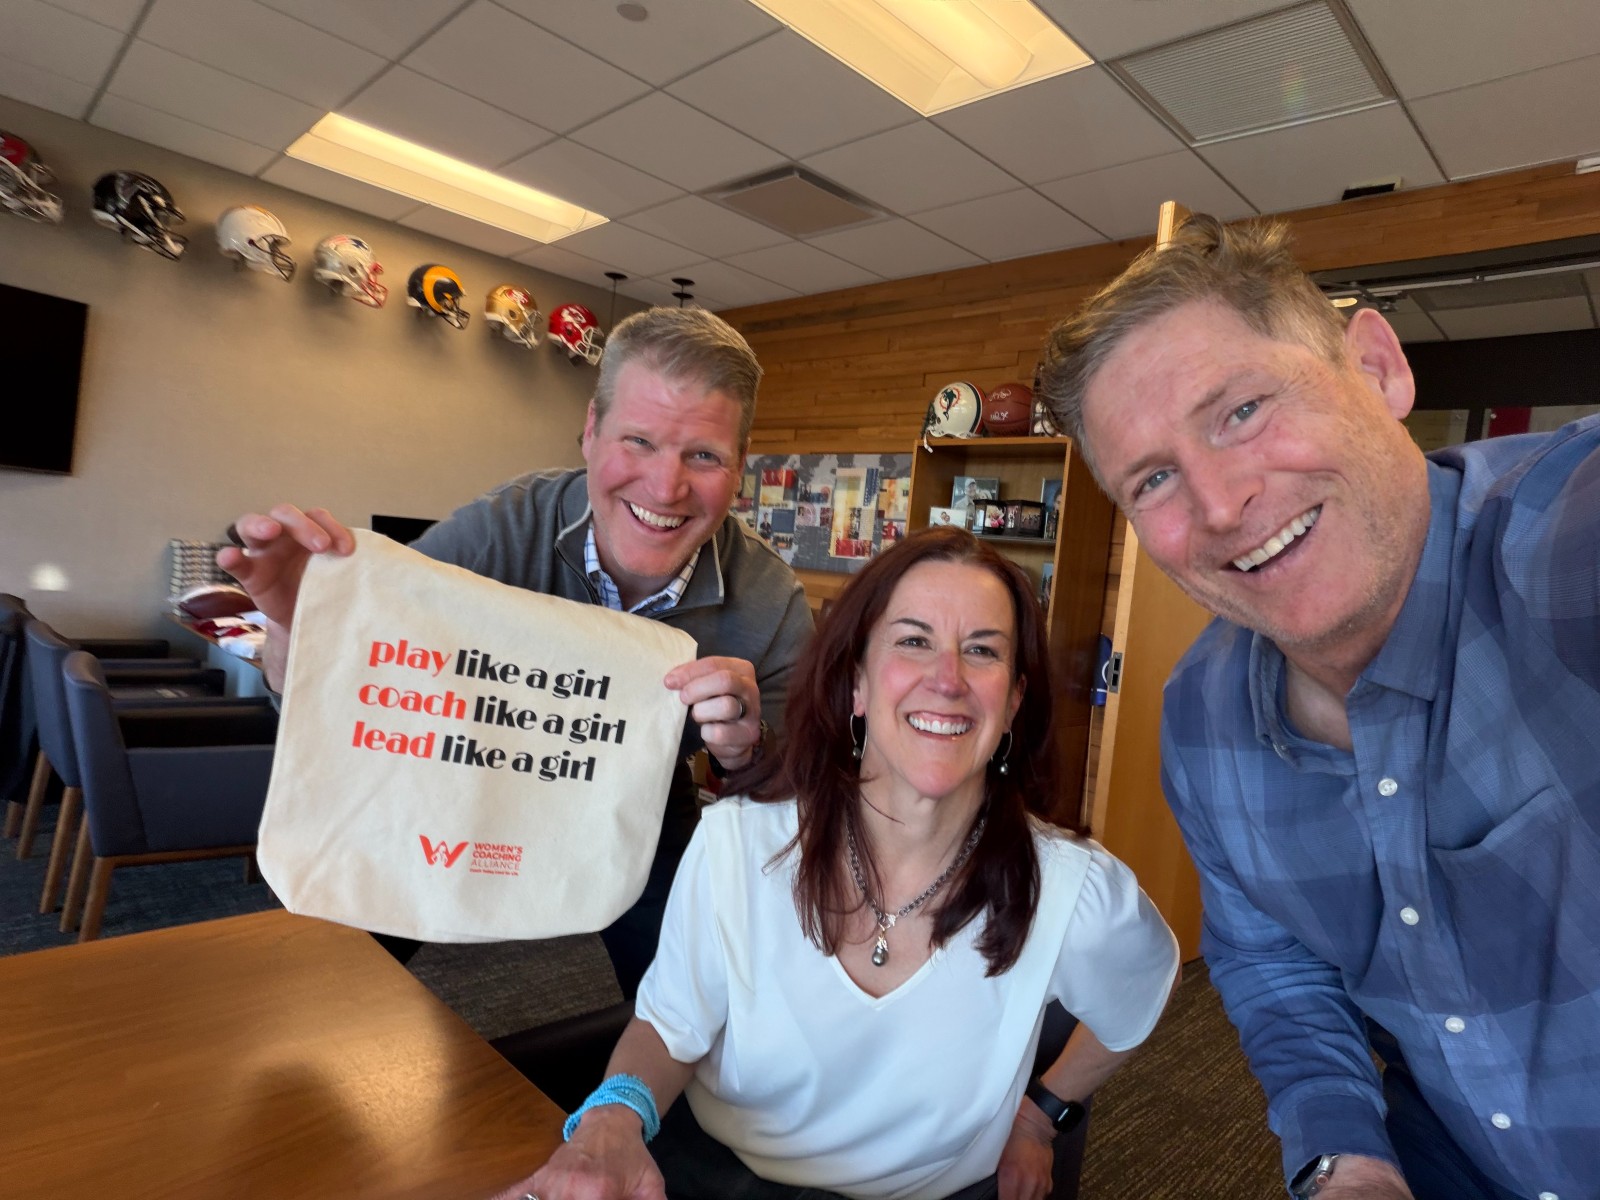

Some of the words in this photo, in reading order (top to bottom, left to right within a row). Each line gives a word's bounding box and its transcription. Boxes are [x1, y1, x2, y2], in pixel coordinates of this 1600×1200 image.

[368, 639, 452, 677] play
[455, 649, 521, 684] like
[525, 668, 548, 690] a
[552, 669, 611, 700] girl
[358, 683, 467, 720] coach
[473, 696, 537, 730] like
[542, 713, 565, 735] a
[568, 713, 627, 744] girl
[351, 721, 436, 759] lead
[440, 735, 506, 769] like
[511, 751, 534, 773] a
[538, 750, 597, 782] girl
[470, 860, 520, 870] ALLIANCE
[472, 851, 522, 862] COACHING
[474, 843, 523, 854] WOMEN'S
